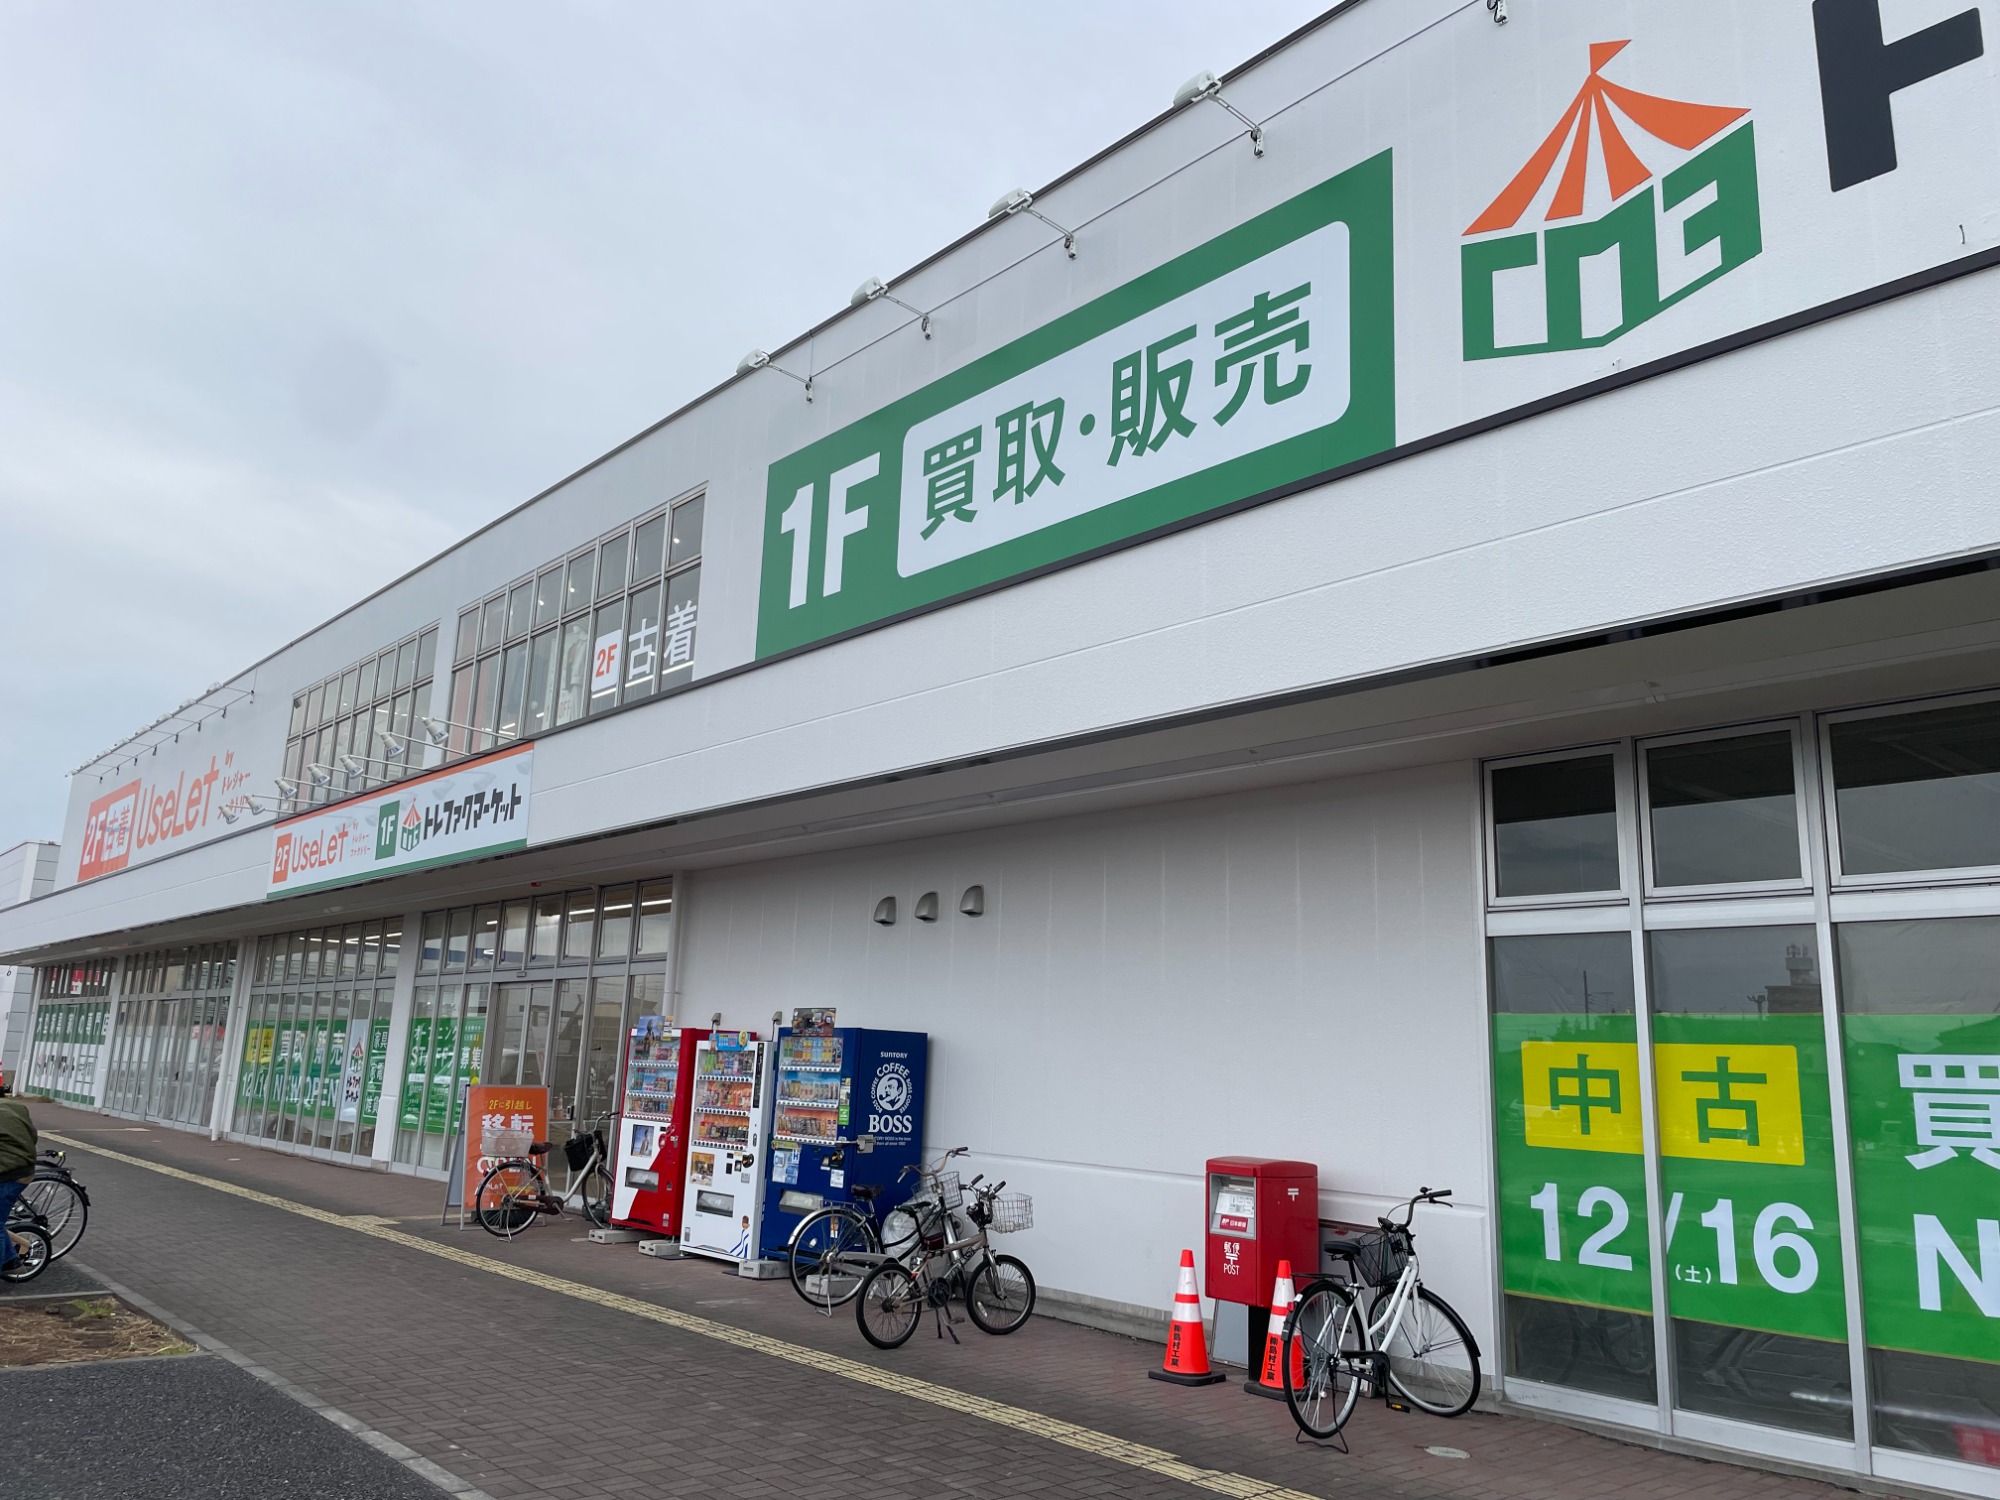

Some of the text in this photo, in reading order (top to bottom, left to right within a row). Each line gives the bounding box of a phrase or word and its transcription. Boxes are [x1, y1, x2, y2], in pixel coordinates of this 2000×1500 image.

[780, 281, 1312, 610] 1F 買取・販売
[595, 600, 698, 681] 2F 古着
[82, 755, 220, 866] 2F 古着 UseLet
[381, 783, 522, 847] 1F トレファクマーケット
[275, 822, 349, 874] 2F UseLet
[876, 1062, 910, 1079] COFFEE
[489, 1100, 532, 1110] 2Fに引越し
[867, 1114, 913, 1134] BOSS
[1548, 1053, 1768, 1147] 中古
[1224, 1242, 1240, 1255] 郵便
[1530, 1182, 1820, 1294] 12/16
[1224, 1263, 1240, 1275] POST
